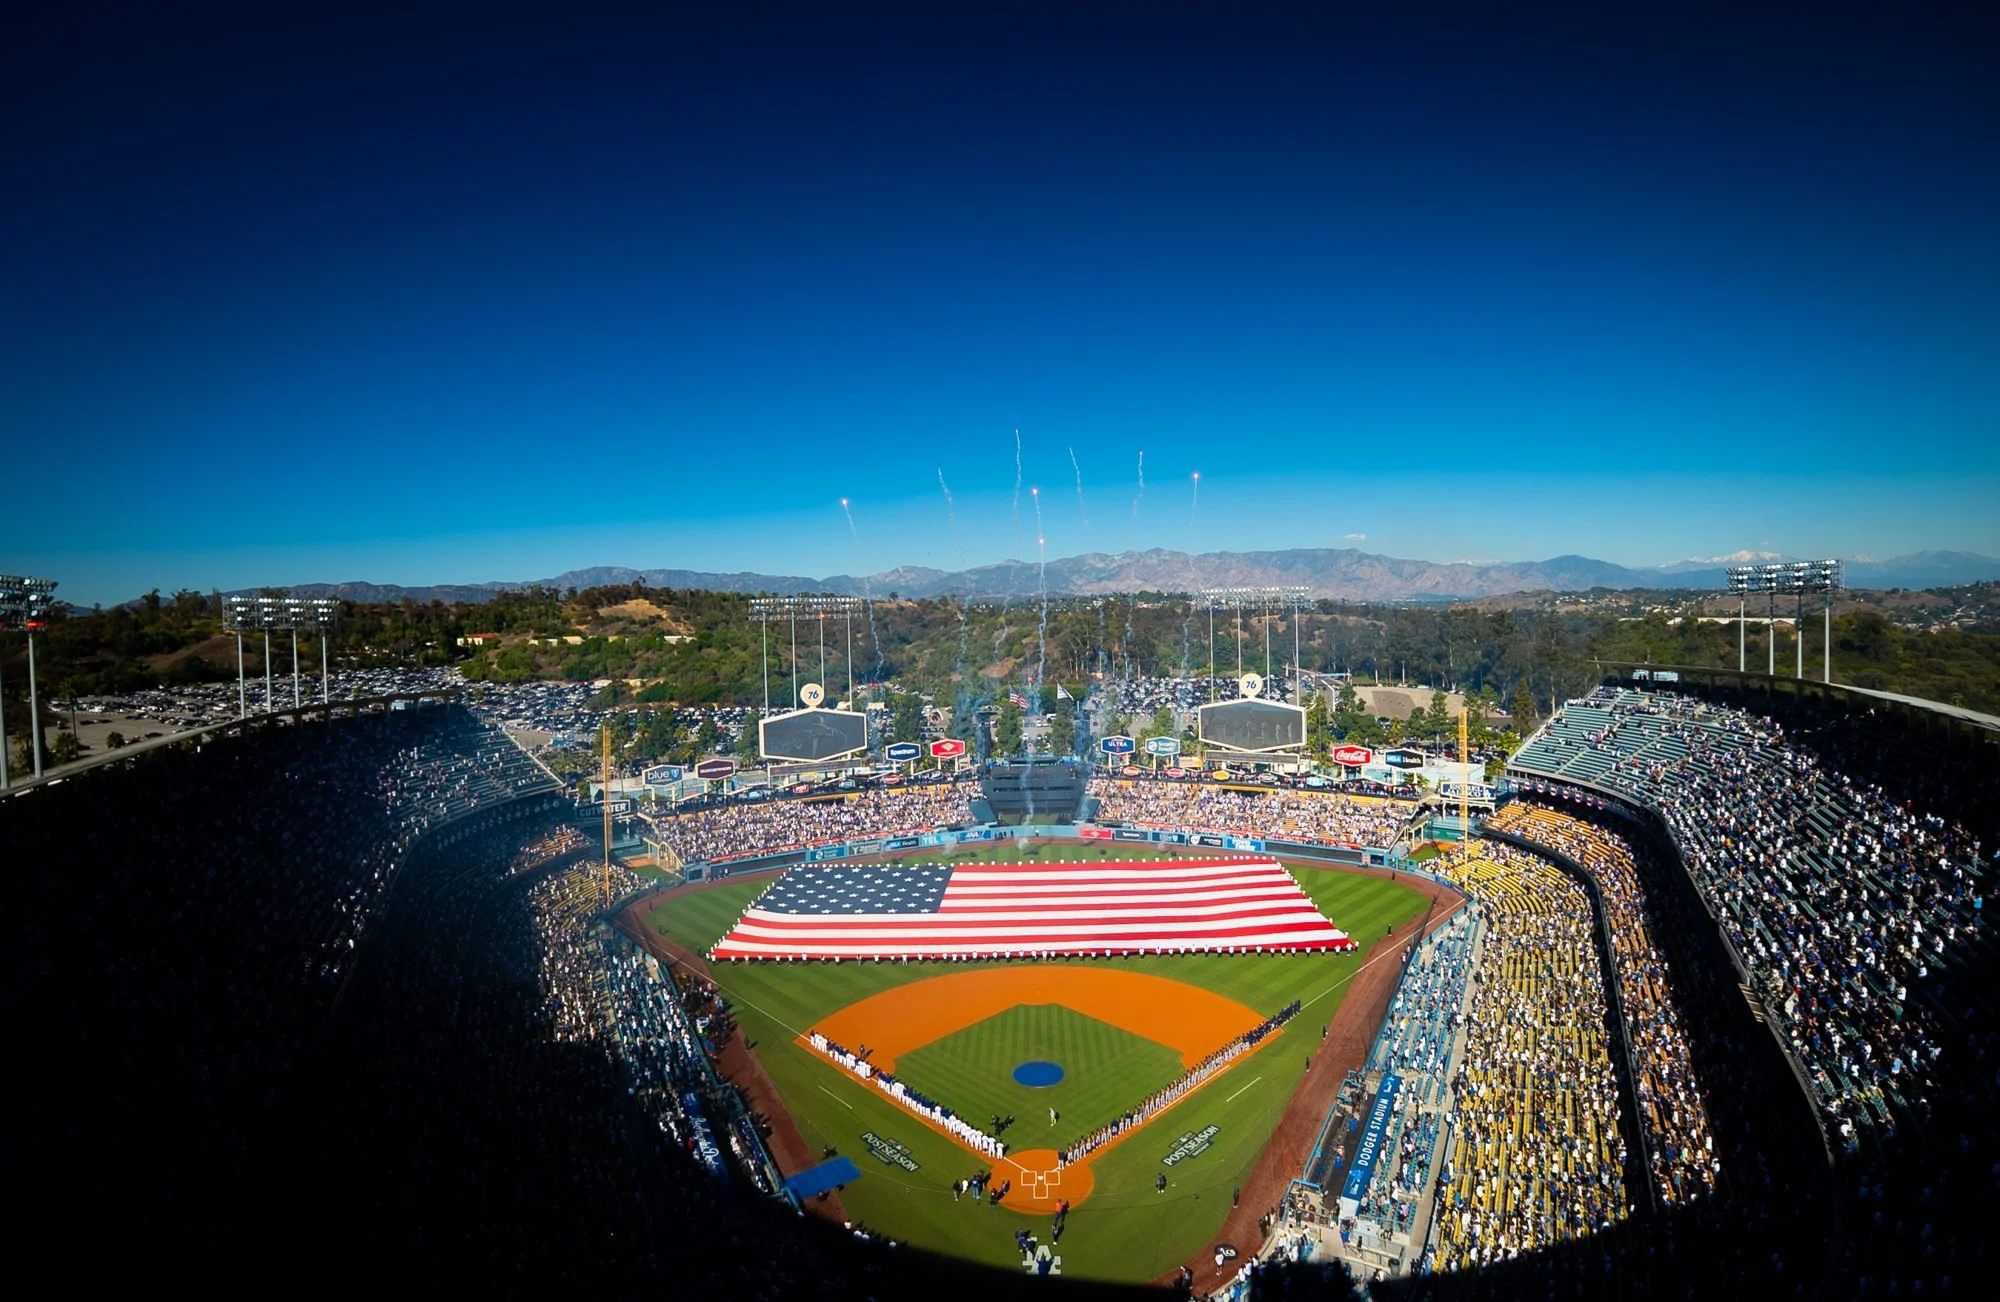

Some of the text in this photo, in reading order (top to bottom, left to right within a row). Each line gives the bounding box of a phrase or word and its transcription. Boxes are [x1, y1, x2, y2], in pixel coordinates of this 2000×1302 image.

[1246, 680, 1257, 689] 76
[808, 690, 819, 699] 76
[890, 748, 916, 756] Spectrum
[647, 769, 670, 780] blue
[1358, 1098, 1389, 1166] DODGER STADIUM
[1163, 1125, 1219, 1166] POSTSEASON
[862, 1132, 919, 1172] POSTSEASON
